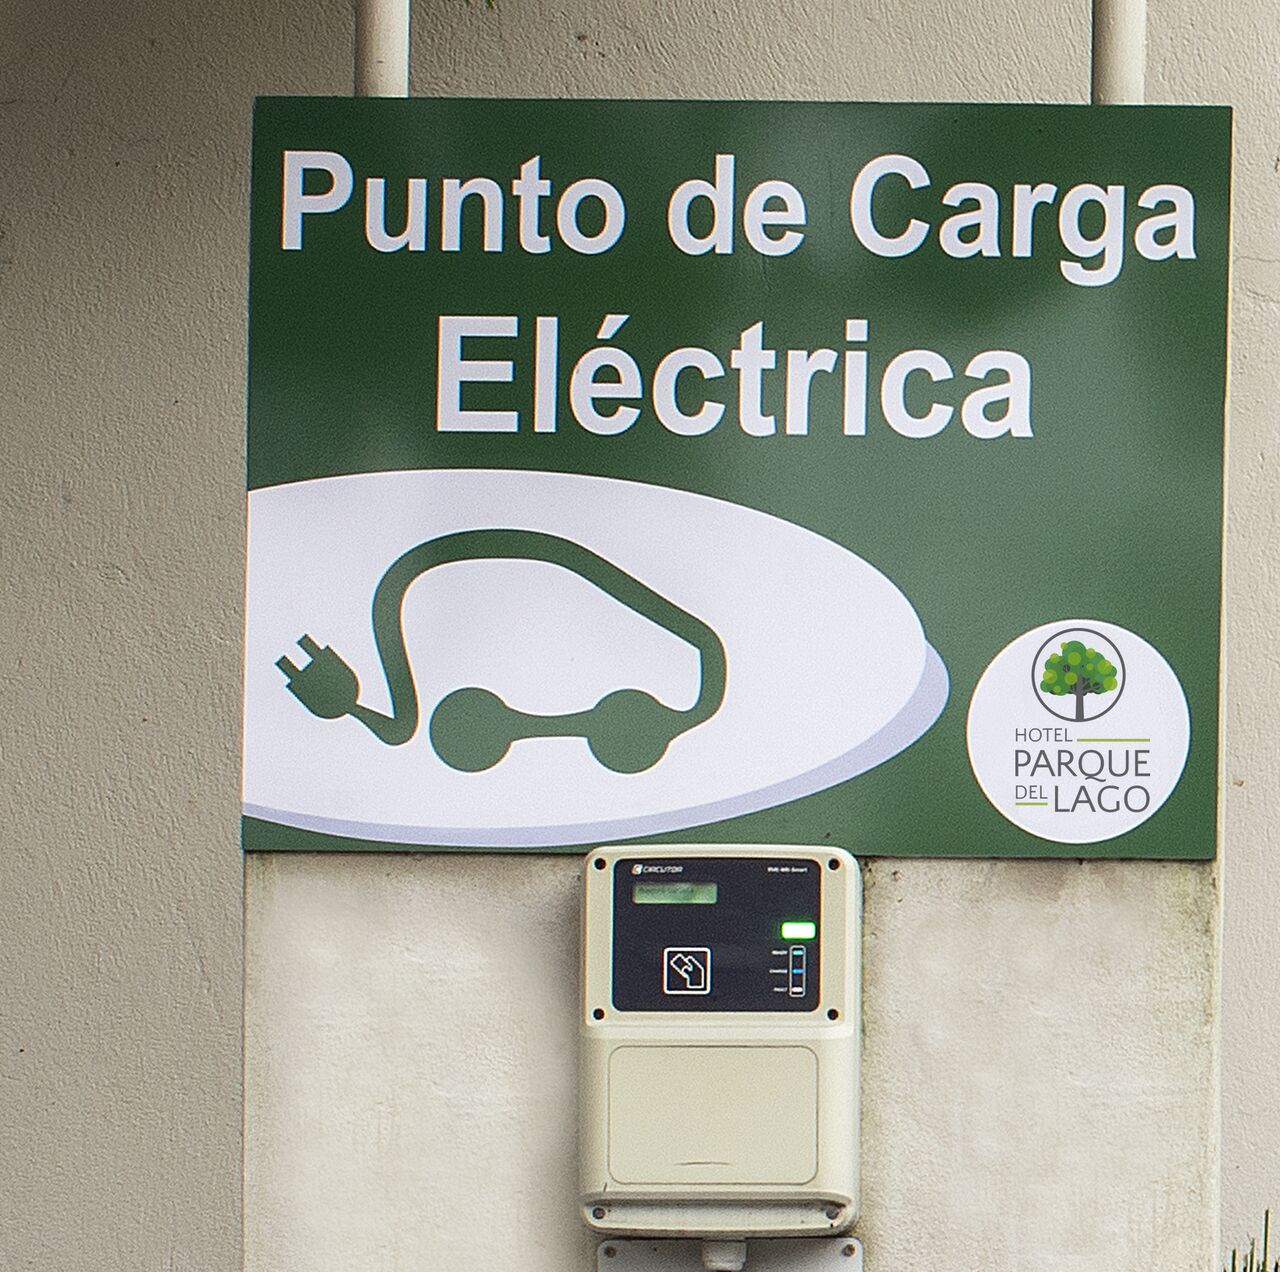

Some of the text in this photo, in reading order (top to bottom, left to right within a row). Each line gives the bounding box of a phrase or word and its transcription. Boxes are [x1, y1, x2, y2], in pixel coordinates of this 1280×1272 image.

[280, 149, 1198, 287] Punto de Carga
[434, 313, 1035, 439] Eléctrica
[1015, 727, 1073, 743] HOTEL
[1014, 749, 1151, 783] PARQUE
[1015, 784, 1151, 813] DEL LAGO
